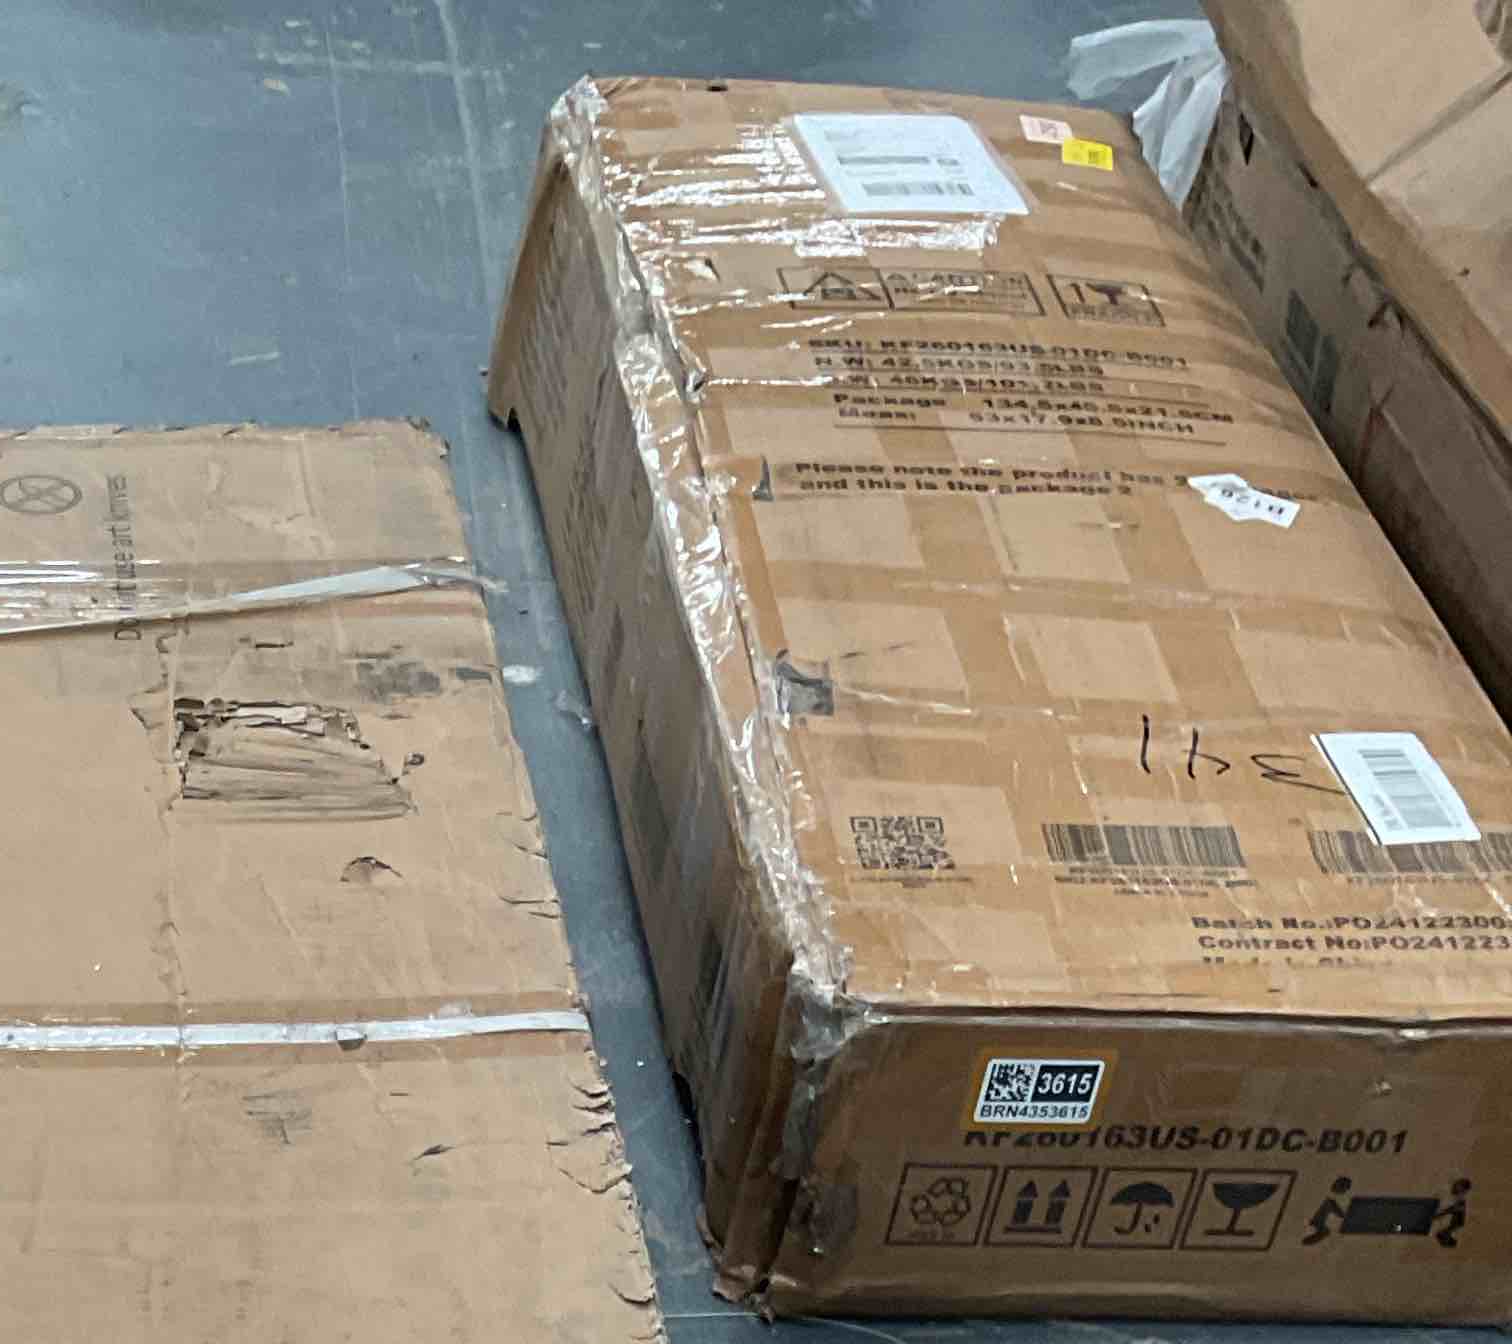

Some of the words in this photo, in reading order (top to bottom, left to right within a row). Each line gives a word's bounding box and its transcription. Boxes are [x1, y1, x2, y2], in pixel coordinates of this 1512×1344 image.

[795, 462, 886, 474] Please
[893, 464, 953, 476] note
[960, 466, 1004, 478] the
[1012, 467, 1112, 482] product
[800, 477, 848, 491] and
[856, 478, 907, 491] this
[915, 478, 938, 491] is
[947, 479, 990, 493] the
[1191, 915, 1273, 930] Batch
[1197, 934, 1316, 950] Contract
[1037, 1071, 1093, 1096] 3615
[979, 1103, 1089, 1120] BRN4353615
